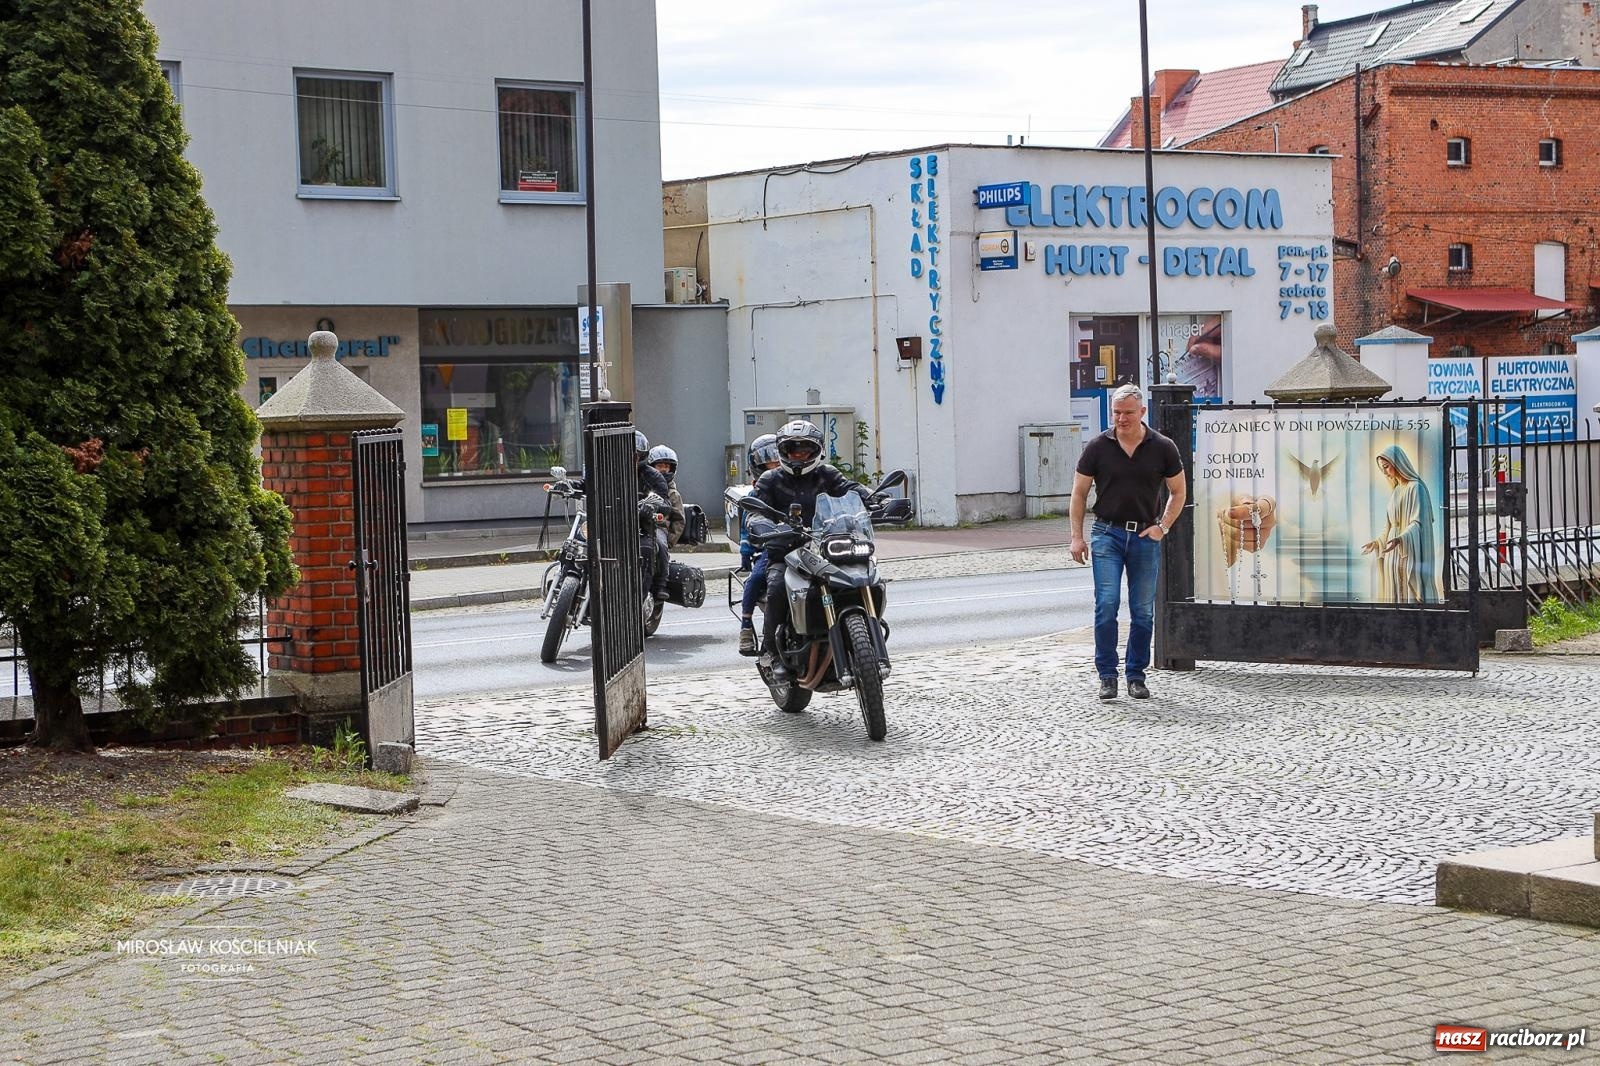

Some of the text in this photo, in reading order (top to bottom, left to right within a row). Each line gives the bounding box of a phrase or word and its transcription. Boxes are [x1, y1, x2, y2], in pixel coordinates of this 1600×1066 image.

[980, 187, 1022, 205] PHILIPS
[909, 157, 923, 279] SKŁAD
[1045, 244, 1129, 276] HURT
[1163, 246, 1256, 277] DETAL
[926, 155, 945, 405] ELEKTRYCZNY
[1279, 262, 1292, 281] 7
[1307, 263, 1330, 282] 17
[1279, 300, 1292, 321] 7
[1308, 300, 1329, 320] 13
[1497, 360, 1569, 375] HURTOWNIA
[1491, 377, 1575, 393] ELEKTRYCZNA
[1205, 419, 1431, 433] RÓŻANIEC W DNI POWSZEDNIE 5:55
[1207, 452, 1259, 464] SCHODY
[1203, 468, 1265, 479] DO NIEBA!
